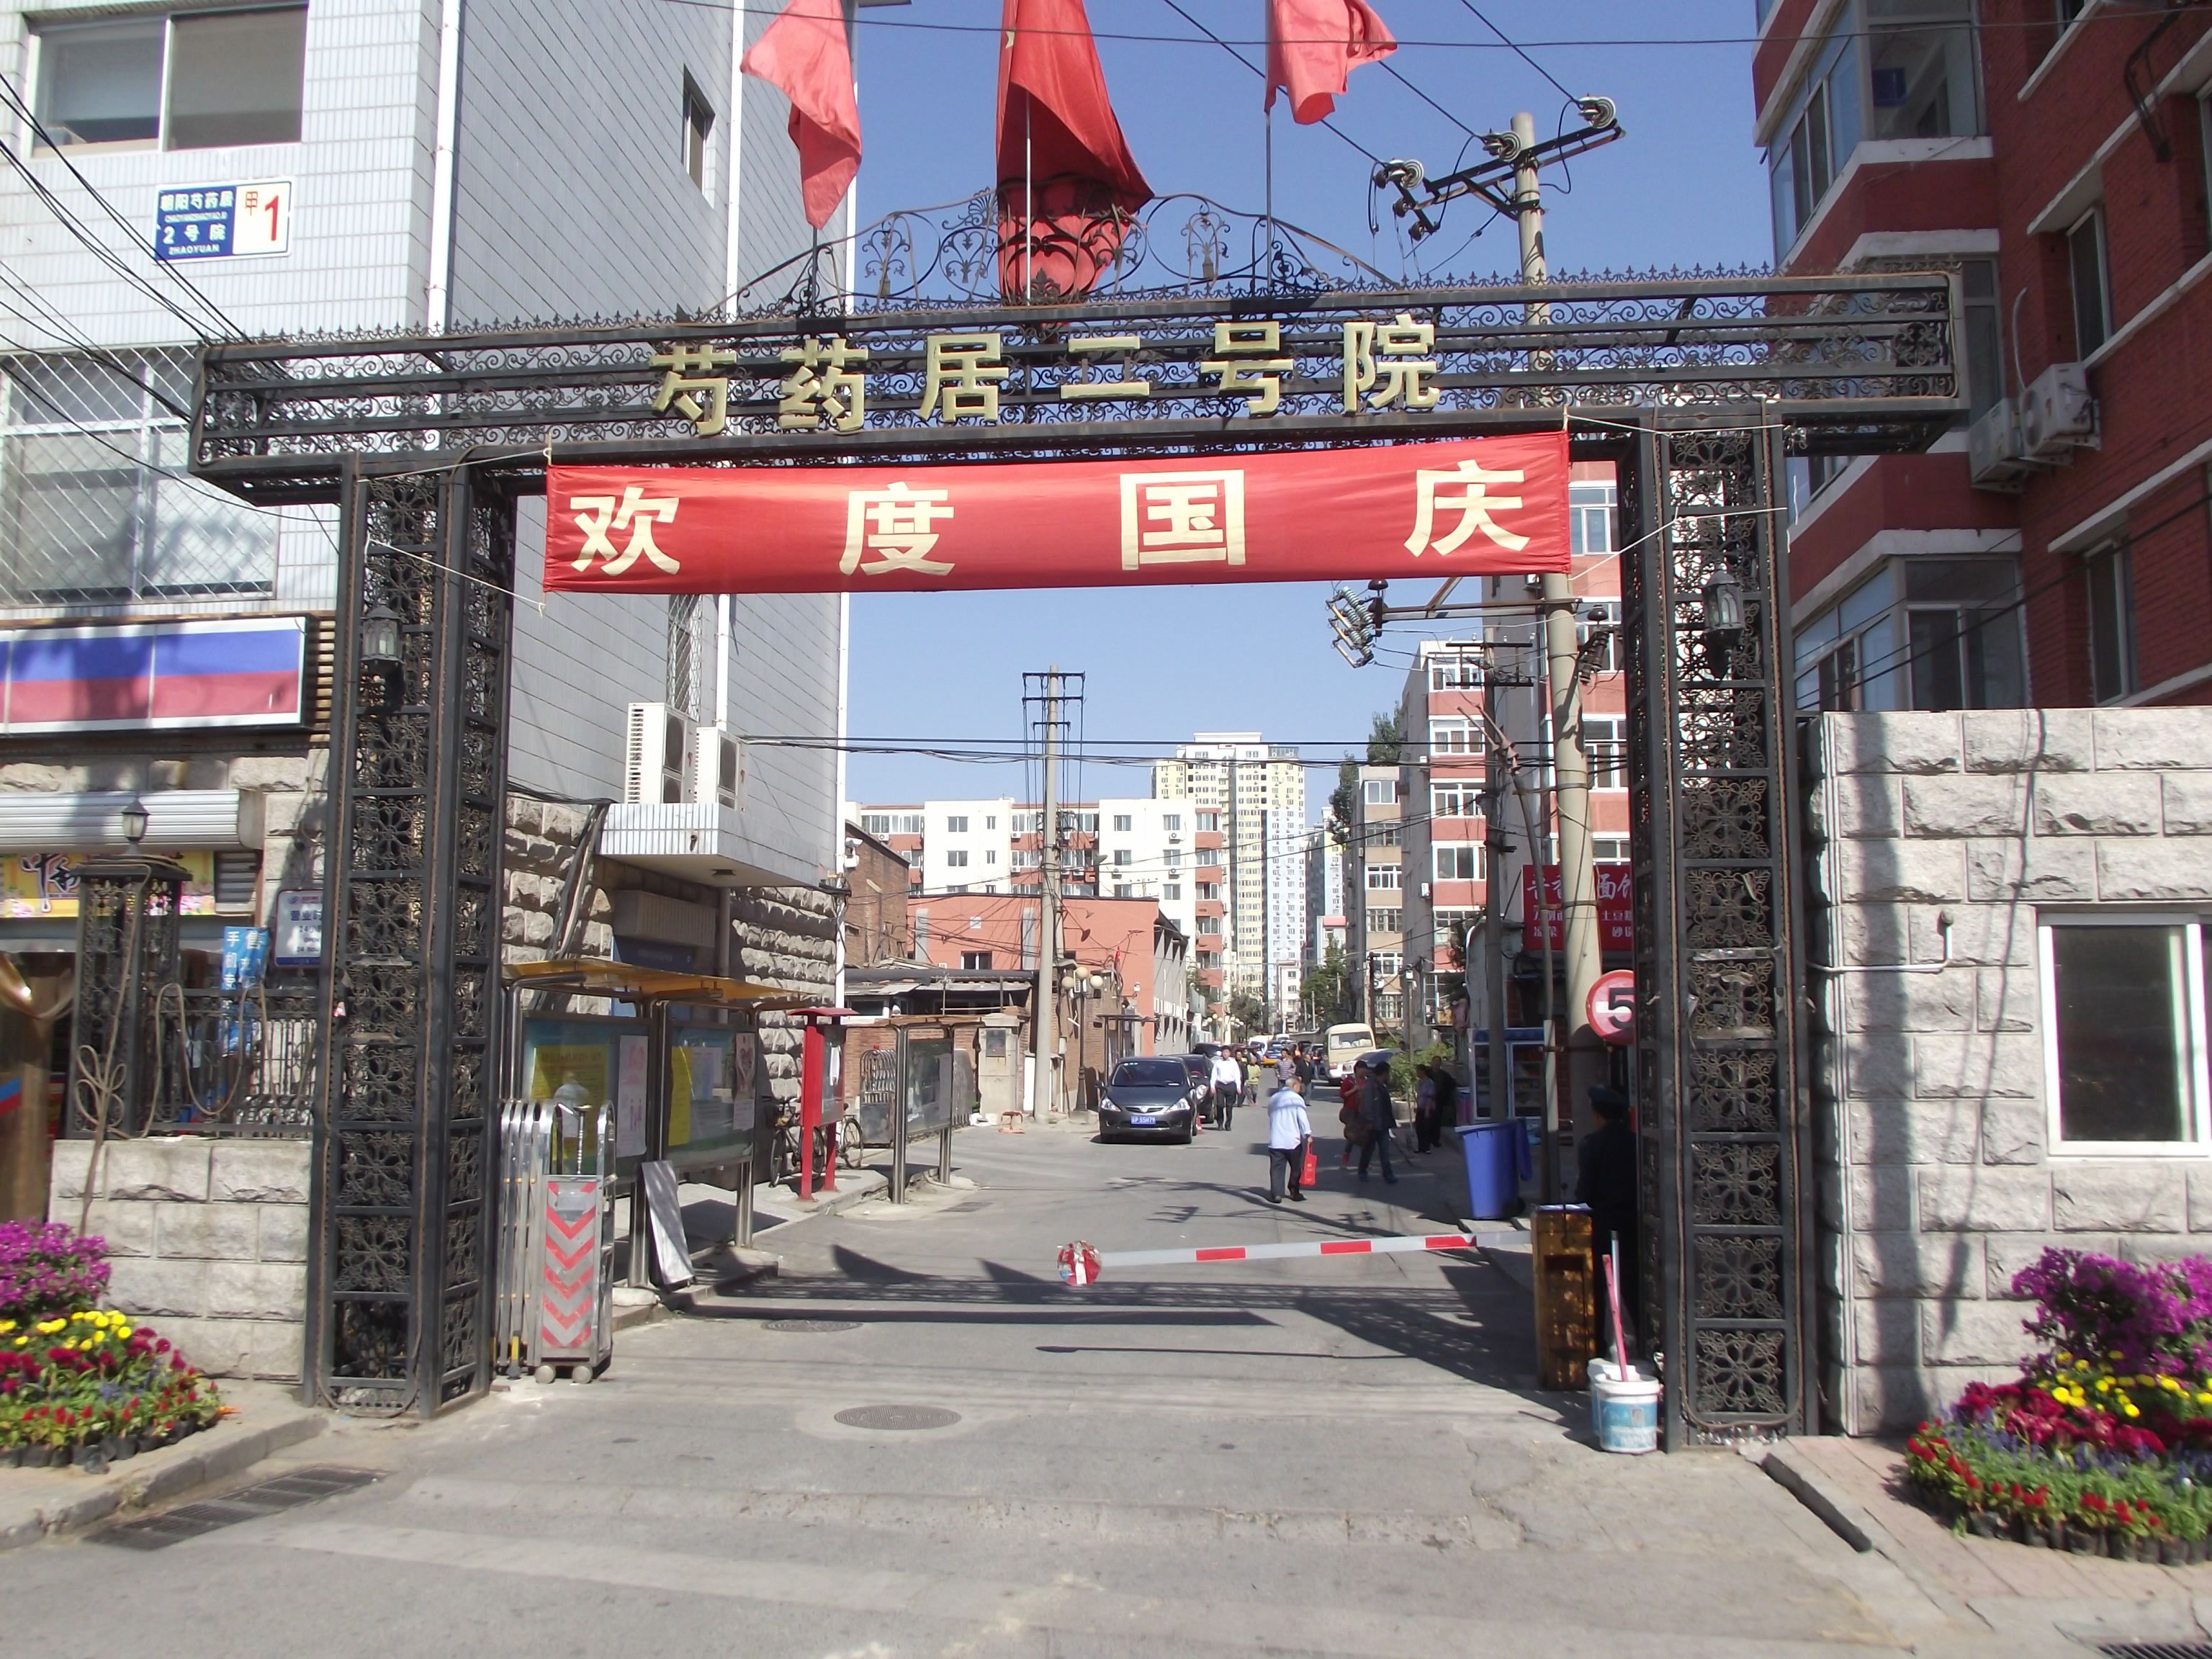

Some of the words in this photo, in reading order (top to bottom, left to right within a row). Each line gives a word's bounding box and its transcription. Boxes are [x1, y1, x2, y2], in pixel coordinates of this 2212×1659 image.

[246, 191, 258, 216] 甲
[264, 194, 279, 241] 1
[652, 313, 1441, 436] 芍药居二号院
[570, 459, 1529, 577] 欢度国庆
